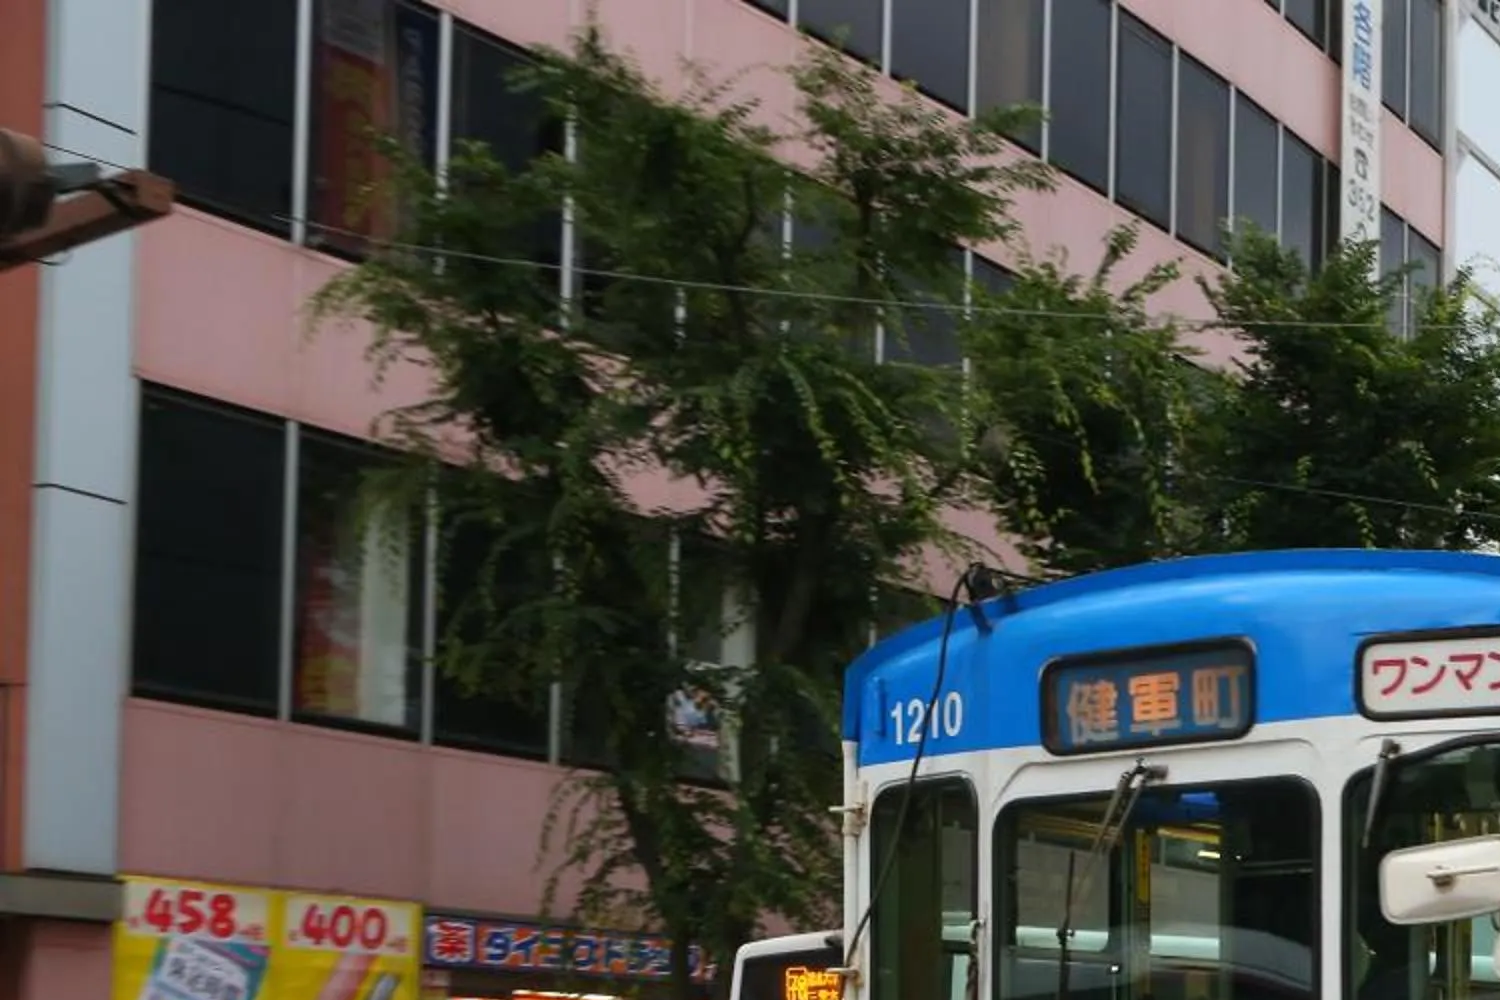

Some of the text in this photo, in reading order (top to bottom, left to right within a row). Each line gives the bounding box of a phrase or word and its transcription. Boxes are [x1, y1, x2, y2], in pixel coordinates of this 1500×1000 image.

[890, 691, 963, 746] 1210
[1066, 666, 1247, 746] 健軍町
[144, 888, 236, 938] 458
[302, 903, 388, 949] 400
